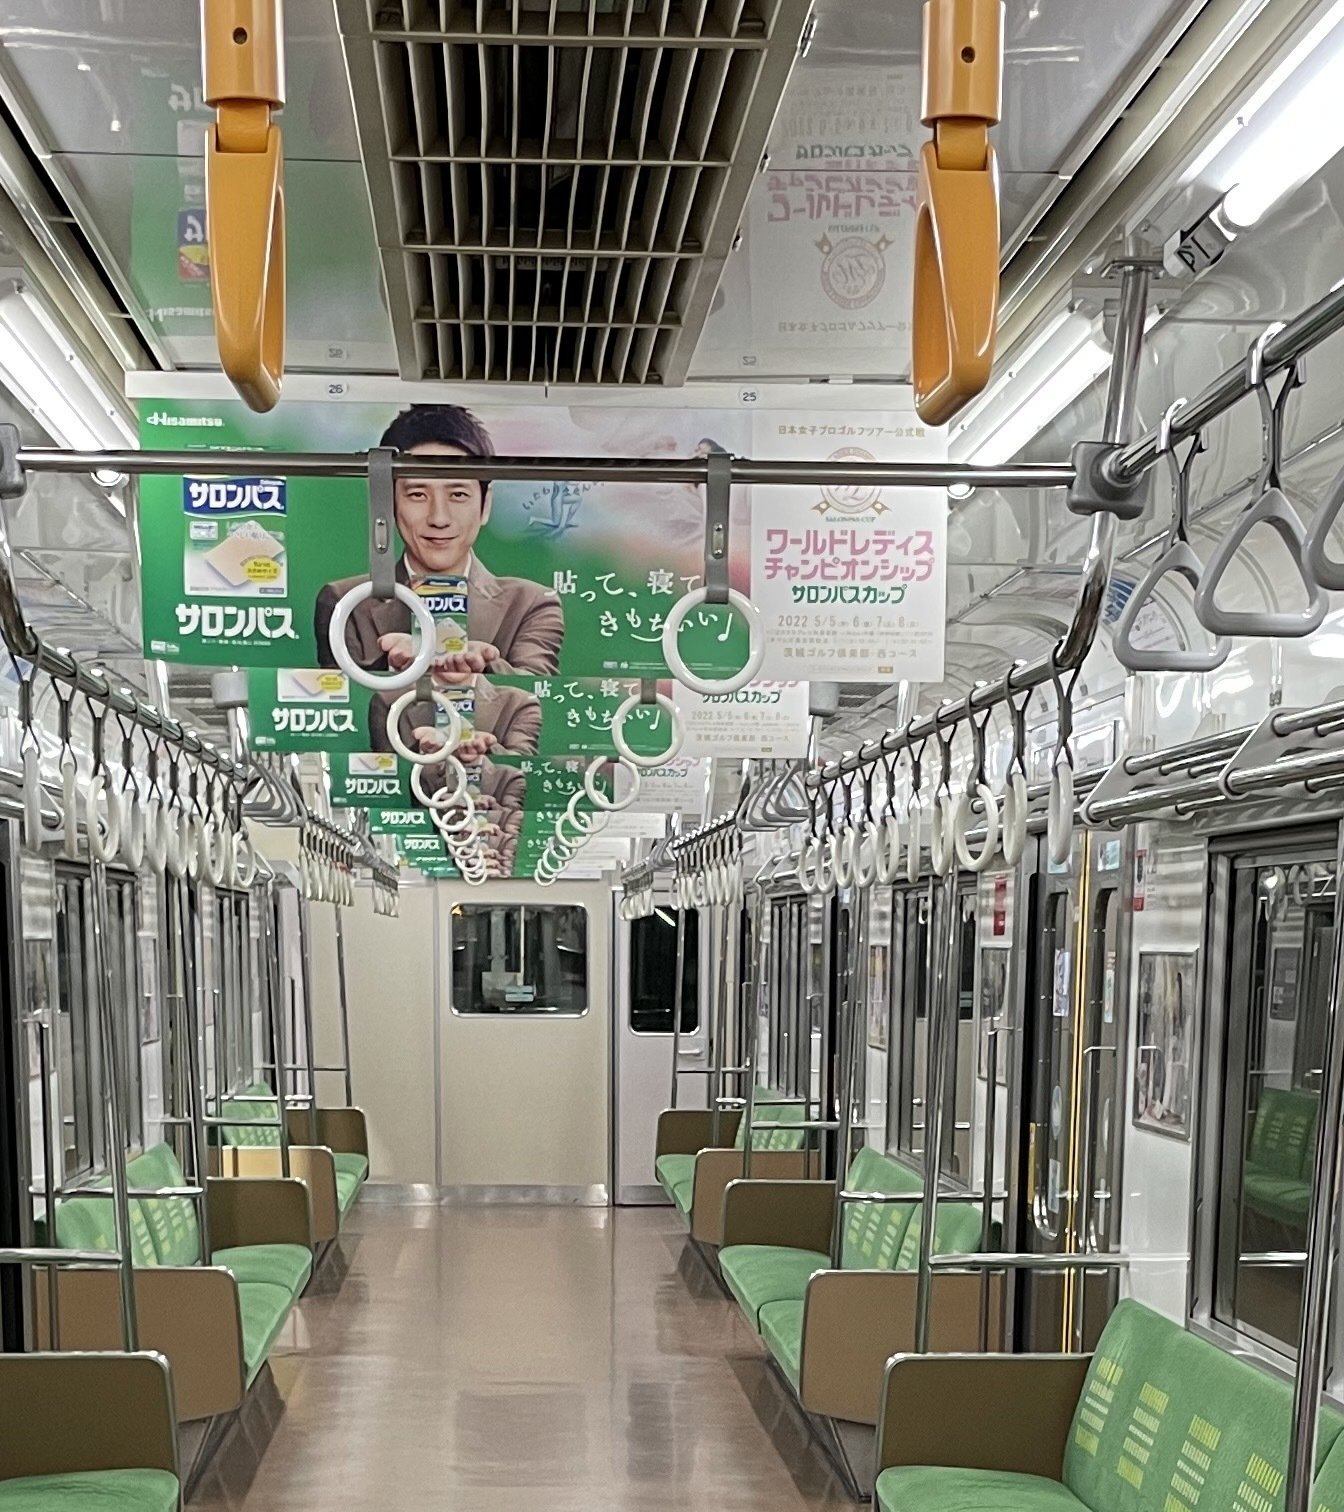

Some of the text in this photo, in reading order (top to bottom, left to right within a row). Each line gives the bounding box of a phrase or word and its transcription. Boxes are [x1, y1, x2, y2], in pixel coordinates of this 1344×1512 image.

[328, 384, 344, 395] 26
[742, 392, 757, 402] 25
[146, 412, 226, 427] Hisamitsu
[189, 483, 285, 510] サロンパス
[766, 528, 935, 556] ワールドレディス
[764, 556, 936, 582] チャンピオンシップ
[791, 583, 909, 604] サロンパスカップ
[175, 603, 296, 640] サロンパス
[778, 615, 809, 628] 2022
[272, 708, 358, 733] サロンパス
[344, 778, 402, 795] サロンパス
[380, 811, 426, 825] サロンパス
